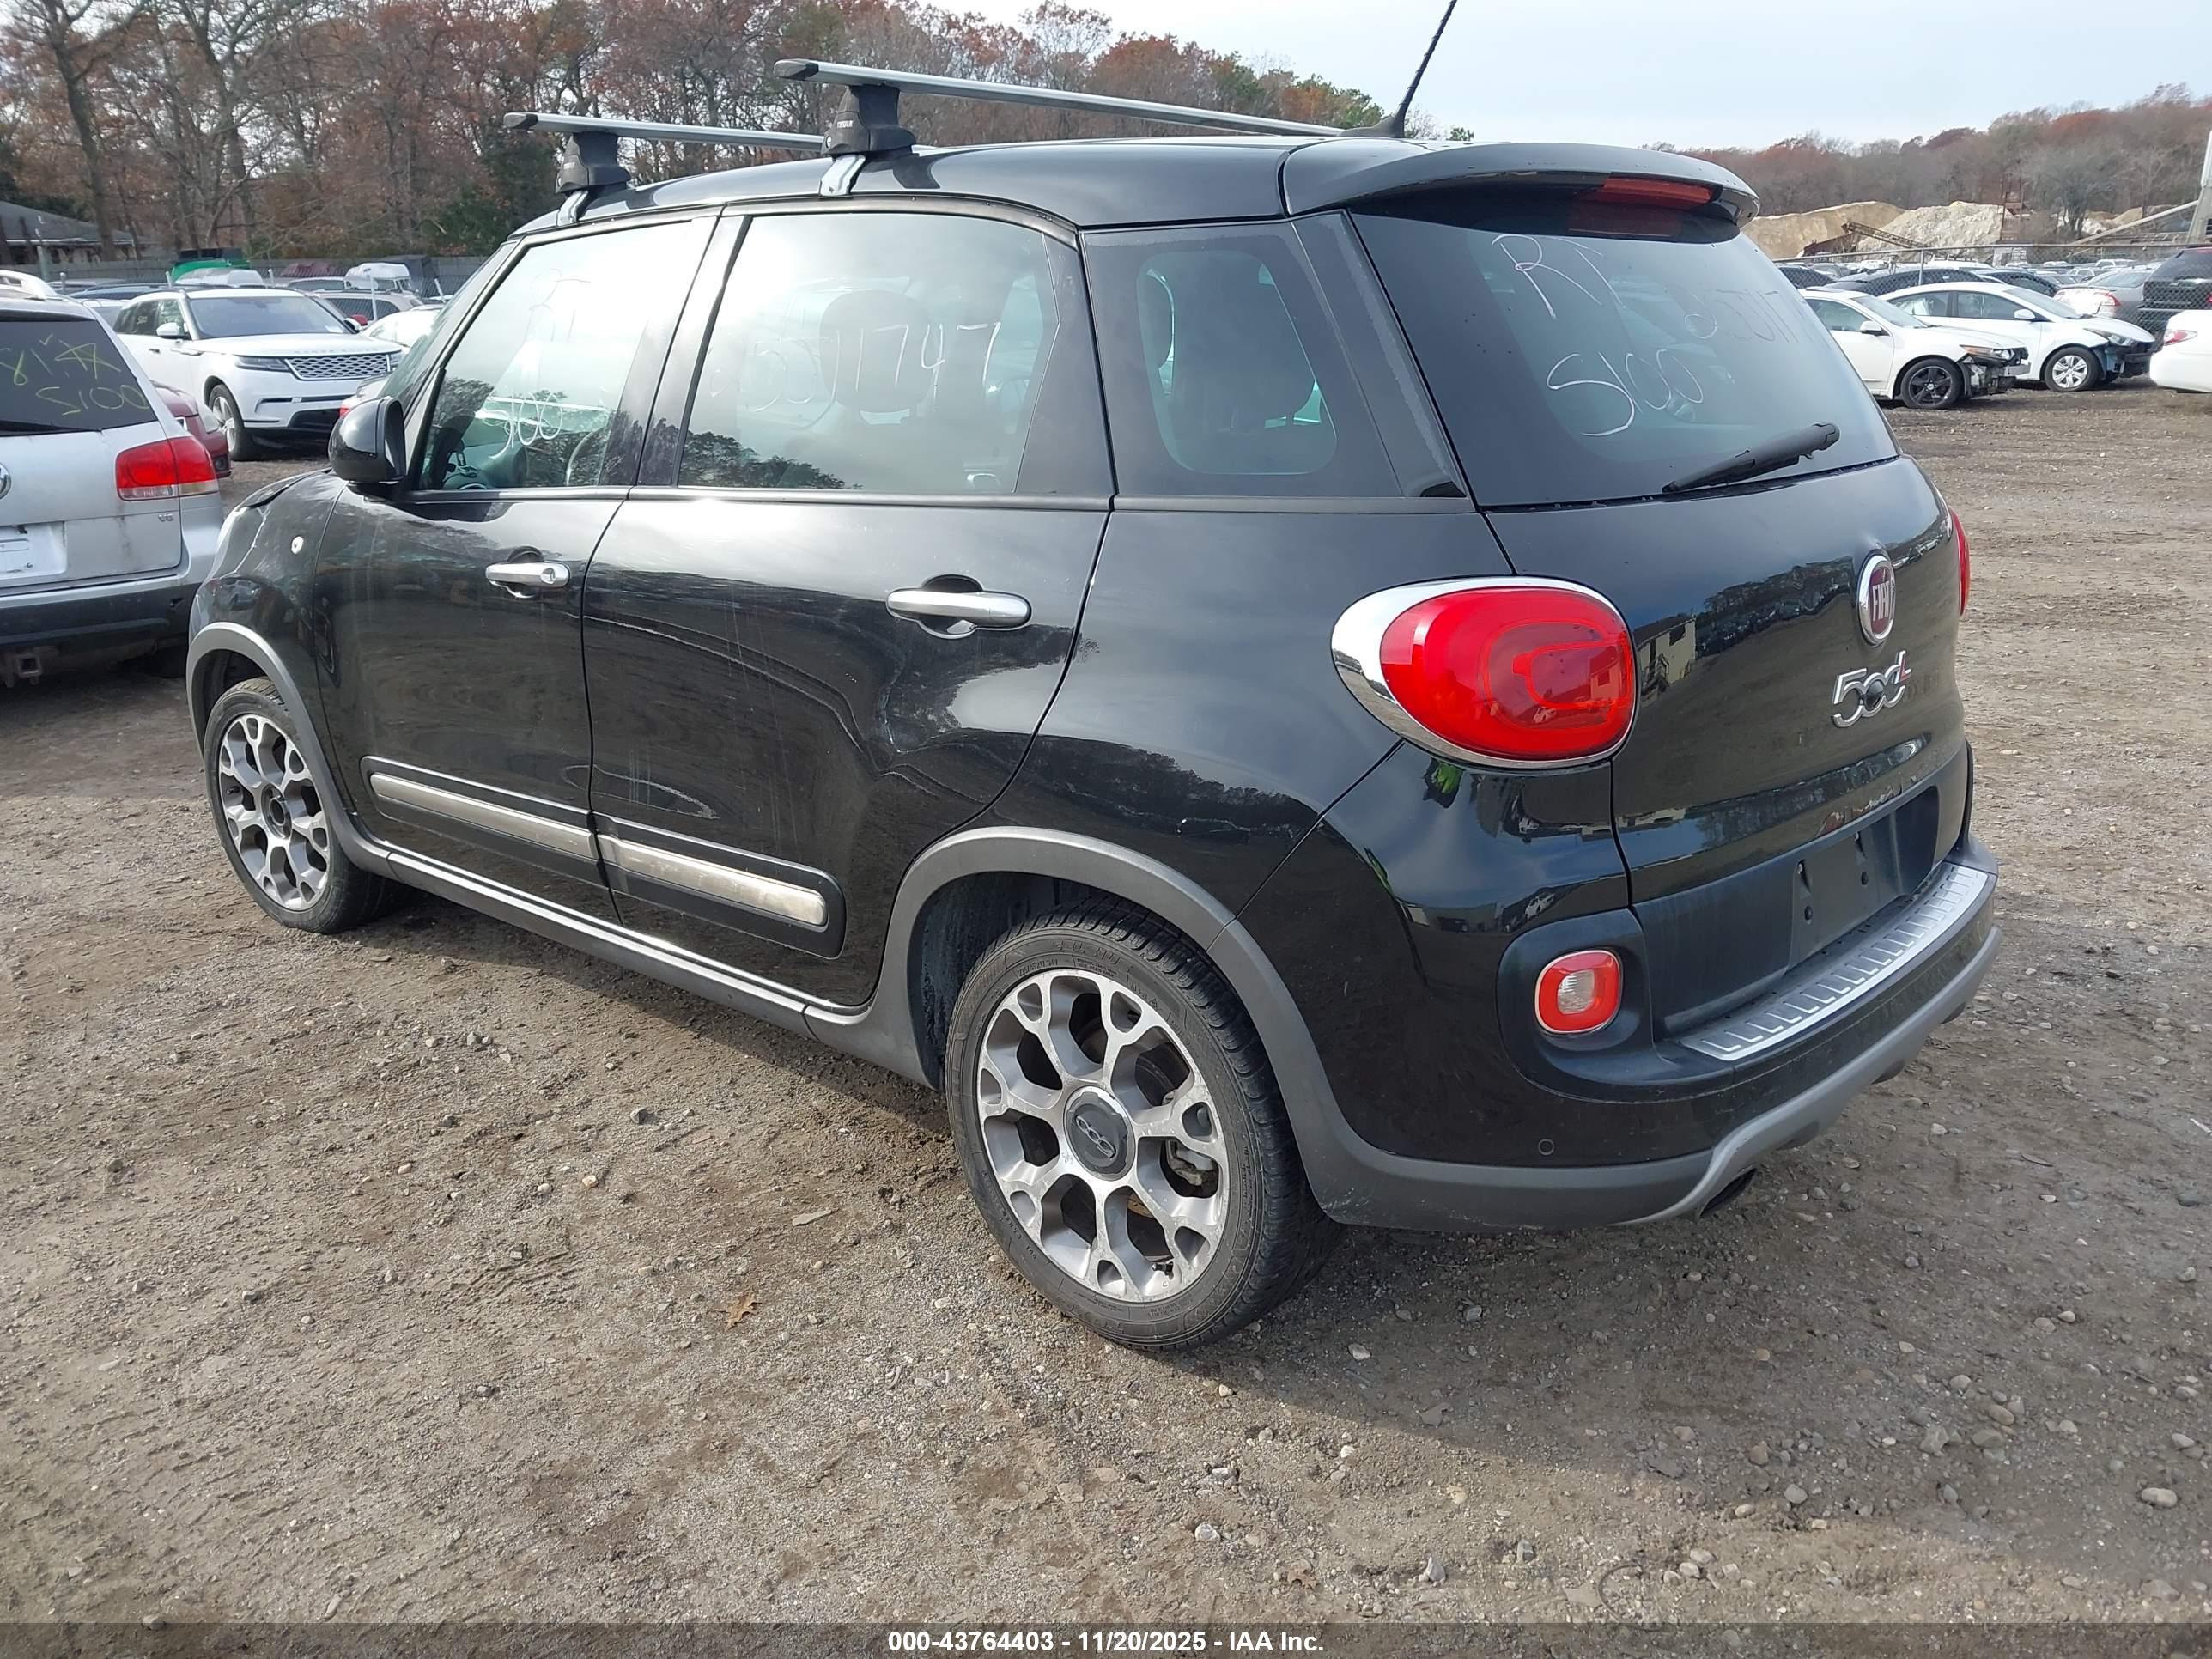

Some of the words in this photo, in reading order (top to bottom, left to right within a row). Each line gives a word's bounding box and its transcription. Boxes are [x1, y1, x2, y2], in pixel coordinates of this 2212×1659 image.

[35, 384, 150, 416] S100
[1547, 349, 1704, 437] S100
[1871, 580, 1890, 622] FIAT
